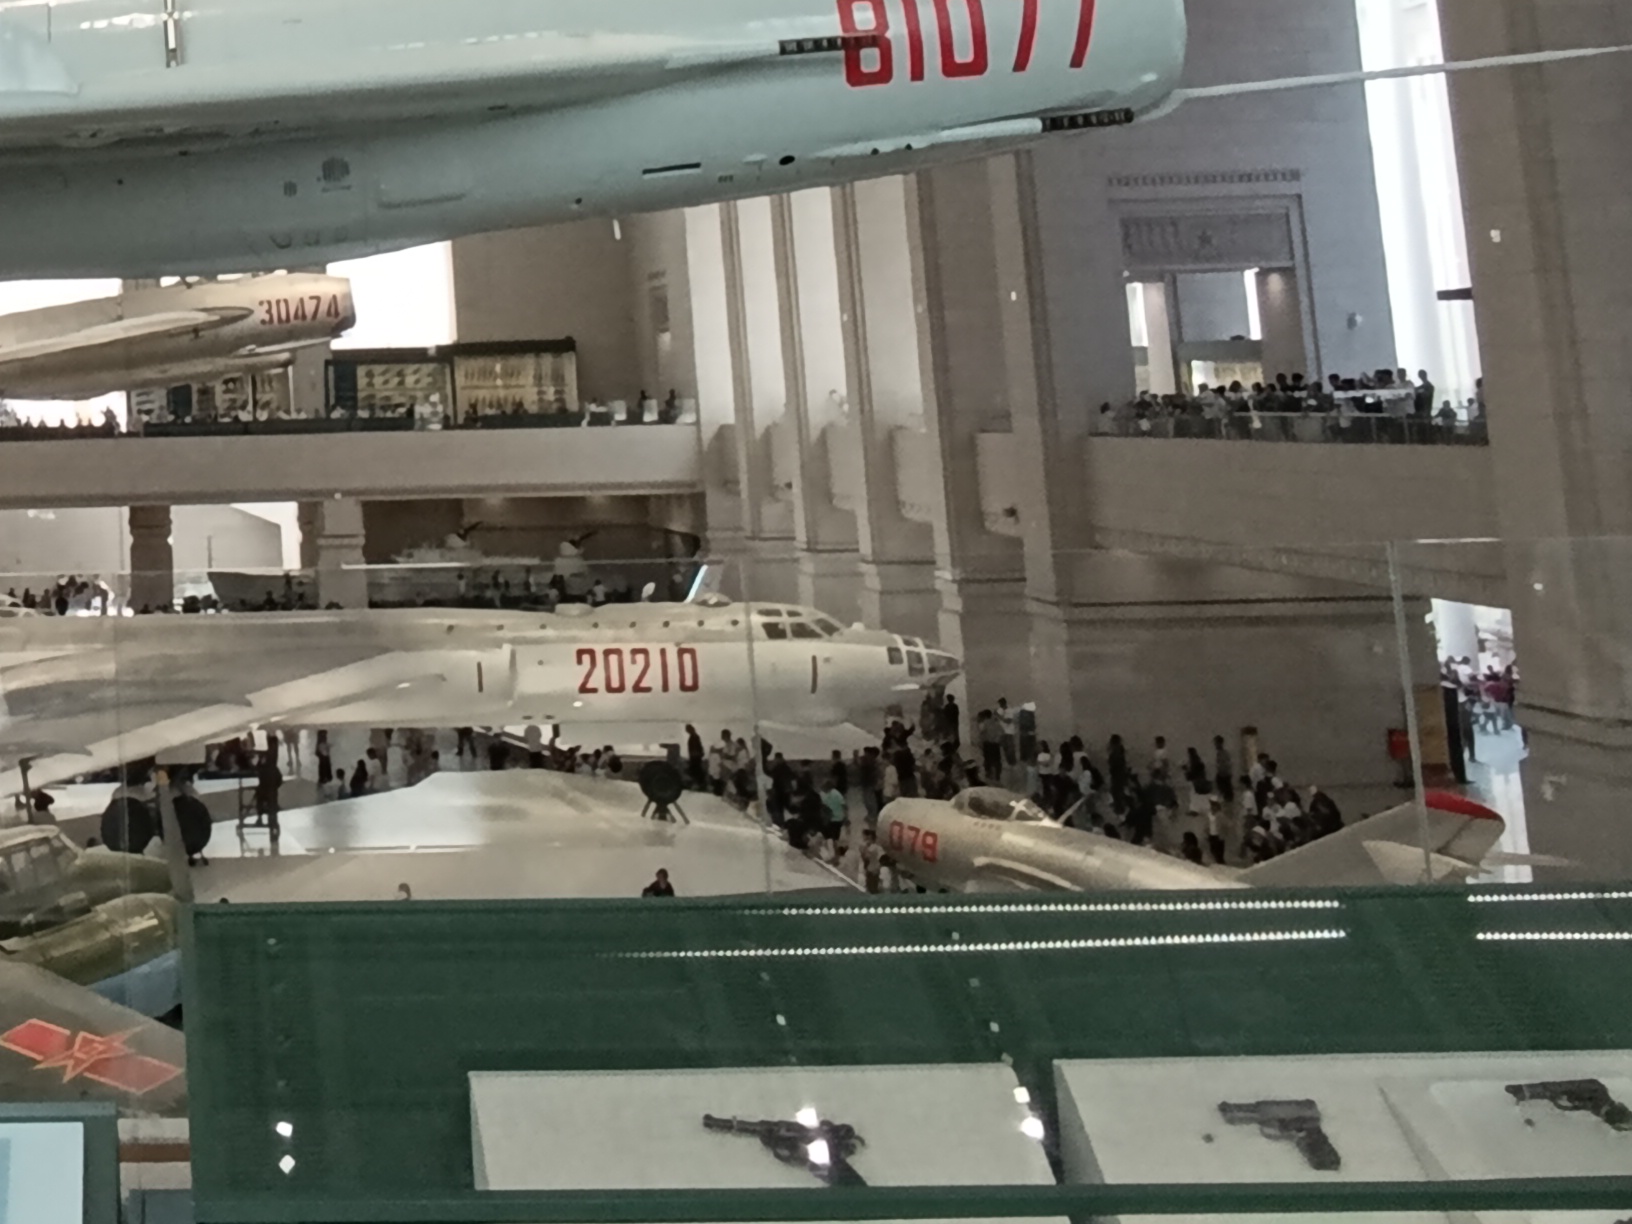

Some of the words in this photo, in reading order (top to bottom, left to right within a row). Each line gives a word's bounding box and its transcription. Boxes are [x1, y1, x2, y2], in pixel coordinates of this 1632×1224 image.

[258, 293, 341, 326] 30474
[575, 647, 700, 695] 20210
[890, 819, 938, 863] 079
